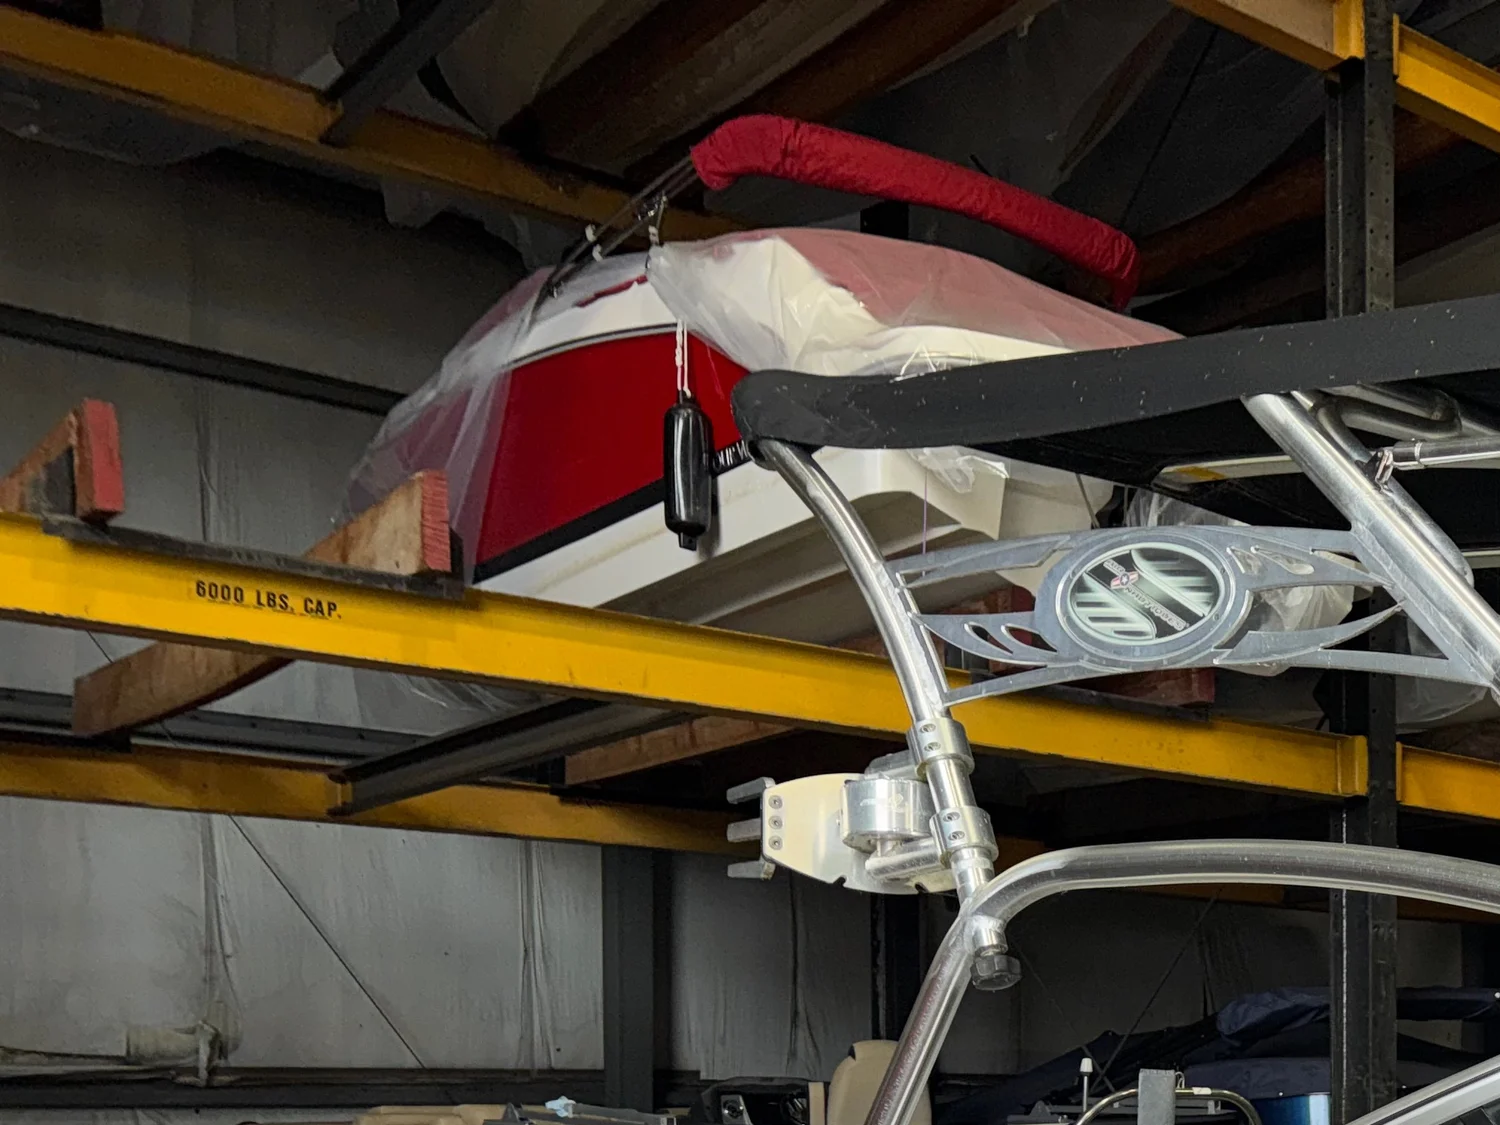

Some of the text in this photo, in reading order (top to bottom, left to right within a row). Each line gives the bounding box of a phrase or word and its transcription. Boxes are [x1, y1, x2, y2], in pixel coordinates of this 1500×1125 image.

[195, 580, 342, 619] 6000 LBS. CAP.
